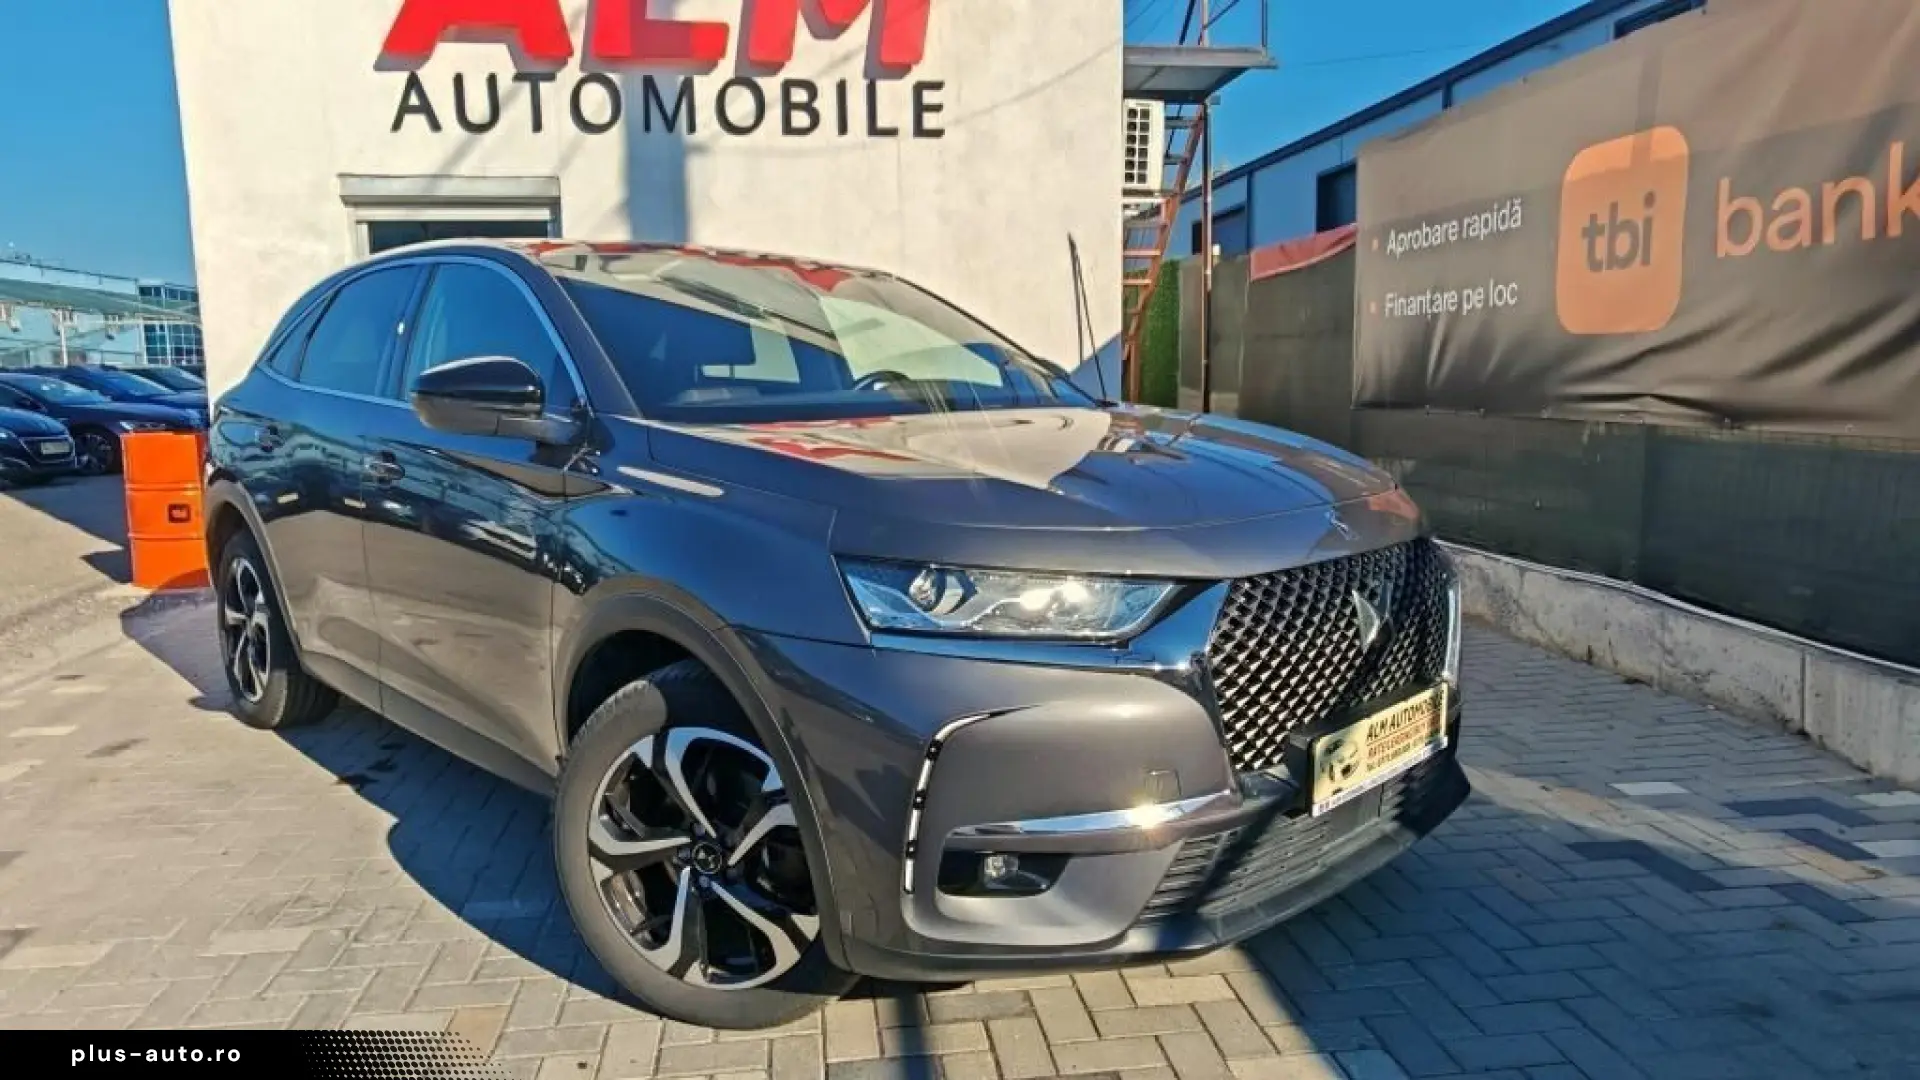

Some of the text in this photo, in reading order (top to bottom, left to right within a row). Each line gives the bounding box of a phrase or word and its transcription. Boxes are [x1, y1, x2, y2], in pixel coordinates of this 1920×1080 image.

[391, 72, 945, 138] AUTOMOBILE
[1386, 197, 1522, 260] Aprobare rapidă
[1581, 141, 1920, 272] tbi bank
[1385, 278, 1518, 322] Finanțare pe loc
